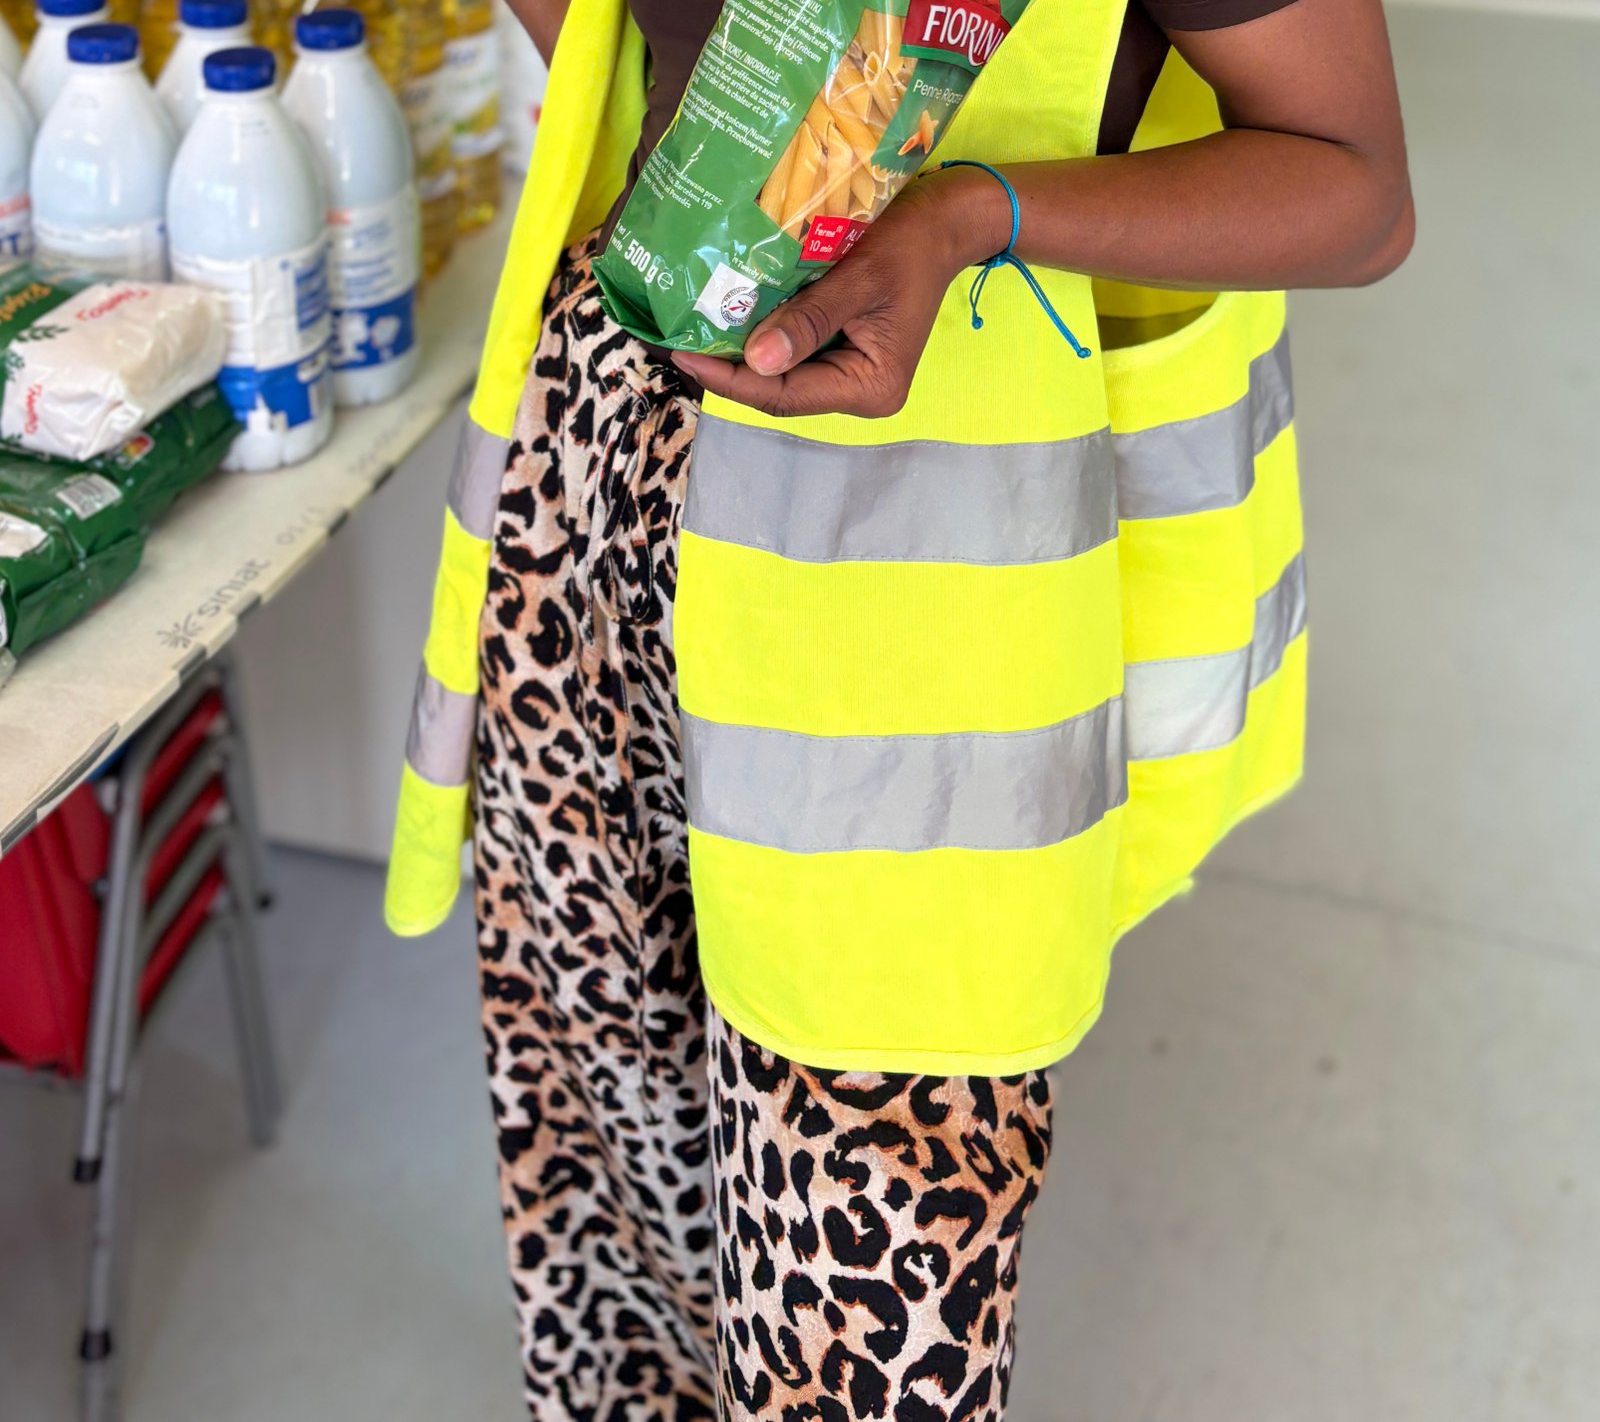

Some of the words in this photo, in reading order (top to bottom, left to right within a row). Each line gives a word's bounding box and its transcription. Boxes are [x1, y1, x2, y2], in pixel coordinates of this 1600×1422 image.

[744, 54, 781, 83] INFORMACJE
[730, 68, 763, 91] préférence
[762, 88, 781, 102] avant
[780, 96, 790, 108] fin
[750, 91, 759, 101] du
[912, 79, 942, 99] Penne
[730, 91, 753, 108] chaleur
[759, 109, 768, 119] de
[726, 125, 773, 159] Przechowywać
[674, 180, 701, 203] Barcelona
[701, 199, 712, 209] 119
[809, 240, 819, 251] 10
[820, 243, 833, 253] min
[625, 239, 651, 272] 500
[644, 266, 658, 283] g
[738, 260, 759, 279] Twardy
